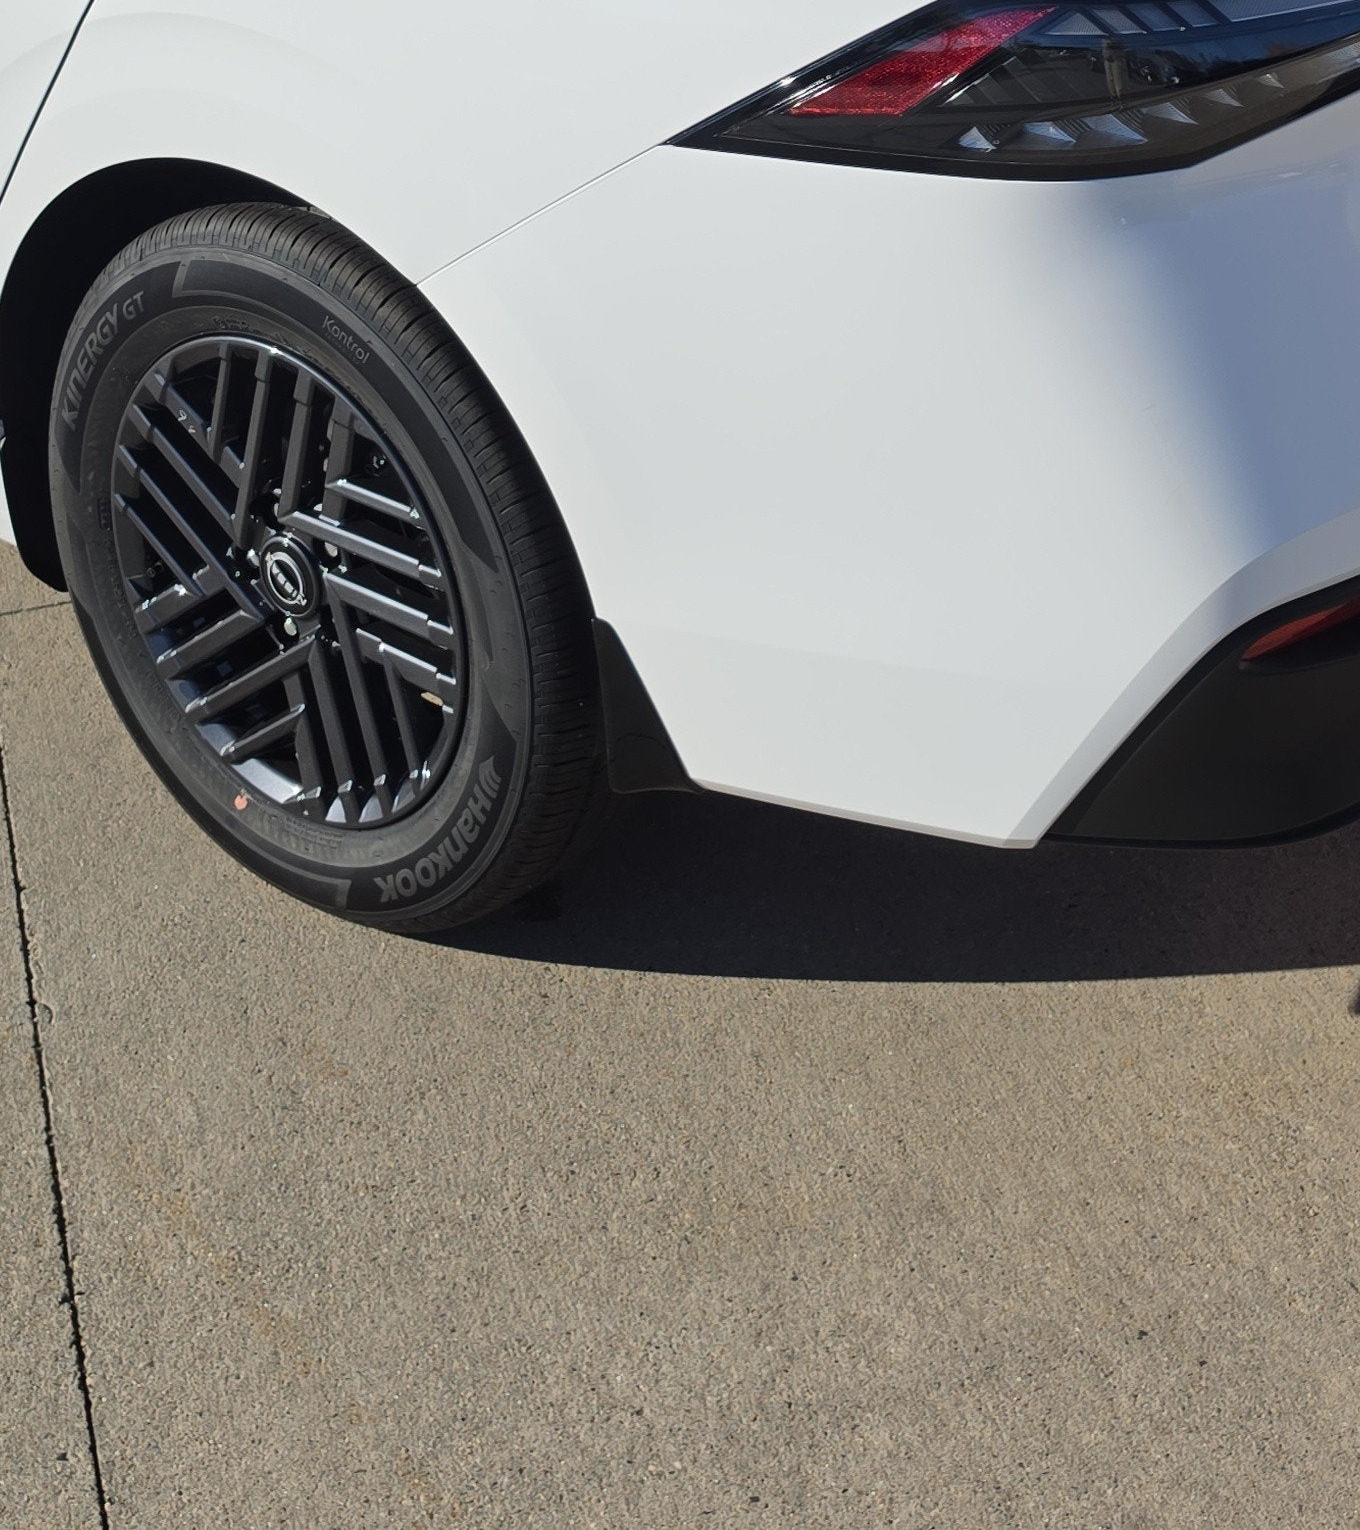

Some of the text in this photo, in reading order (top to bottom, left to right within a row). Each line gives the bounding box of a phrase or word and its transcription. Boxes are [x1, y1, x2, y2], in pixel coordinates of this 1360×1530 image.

[61, 290, 145, 431] KINERGY GT
[321, 315, 371, 364] Kontrol
